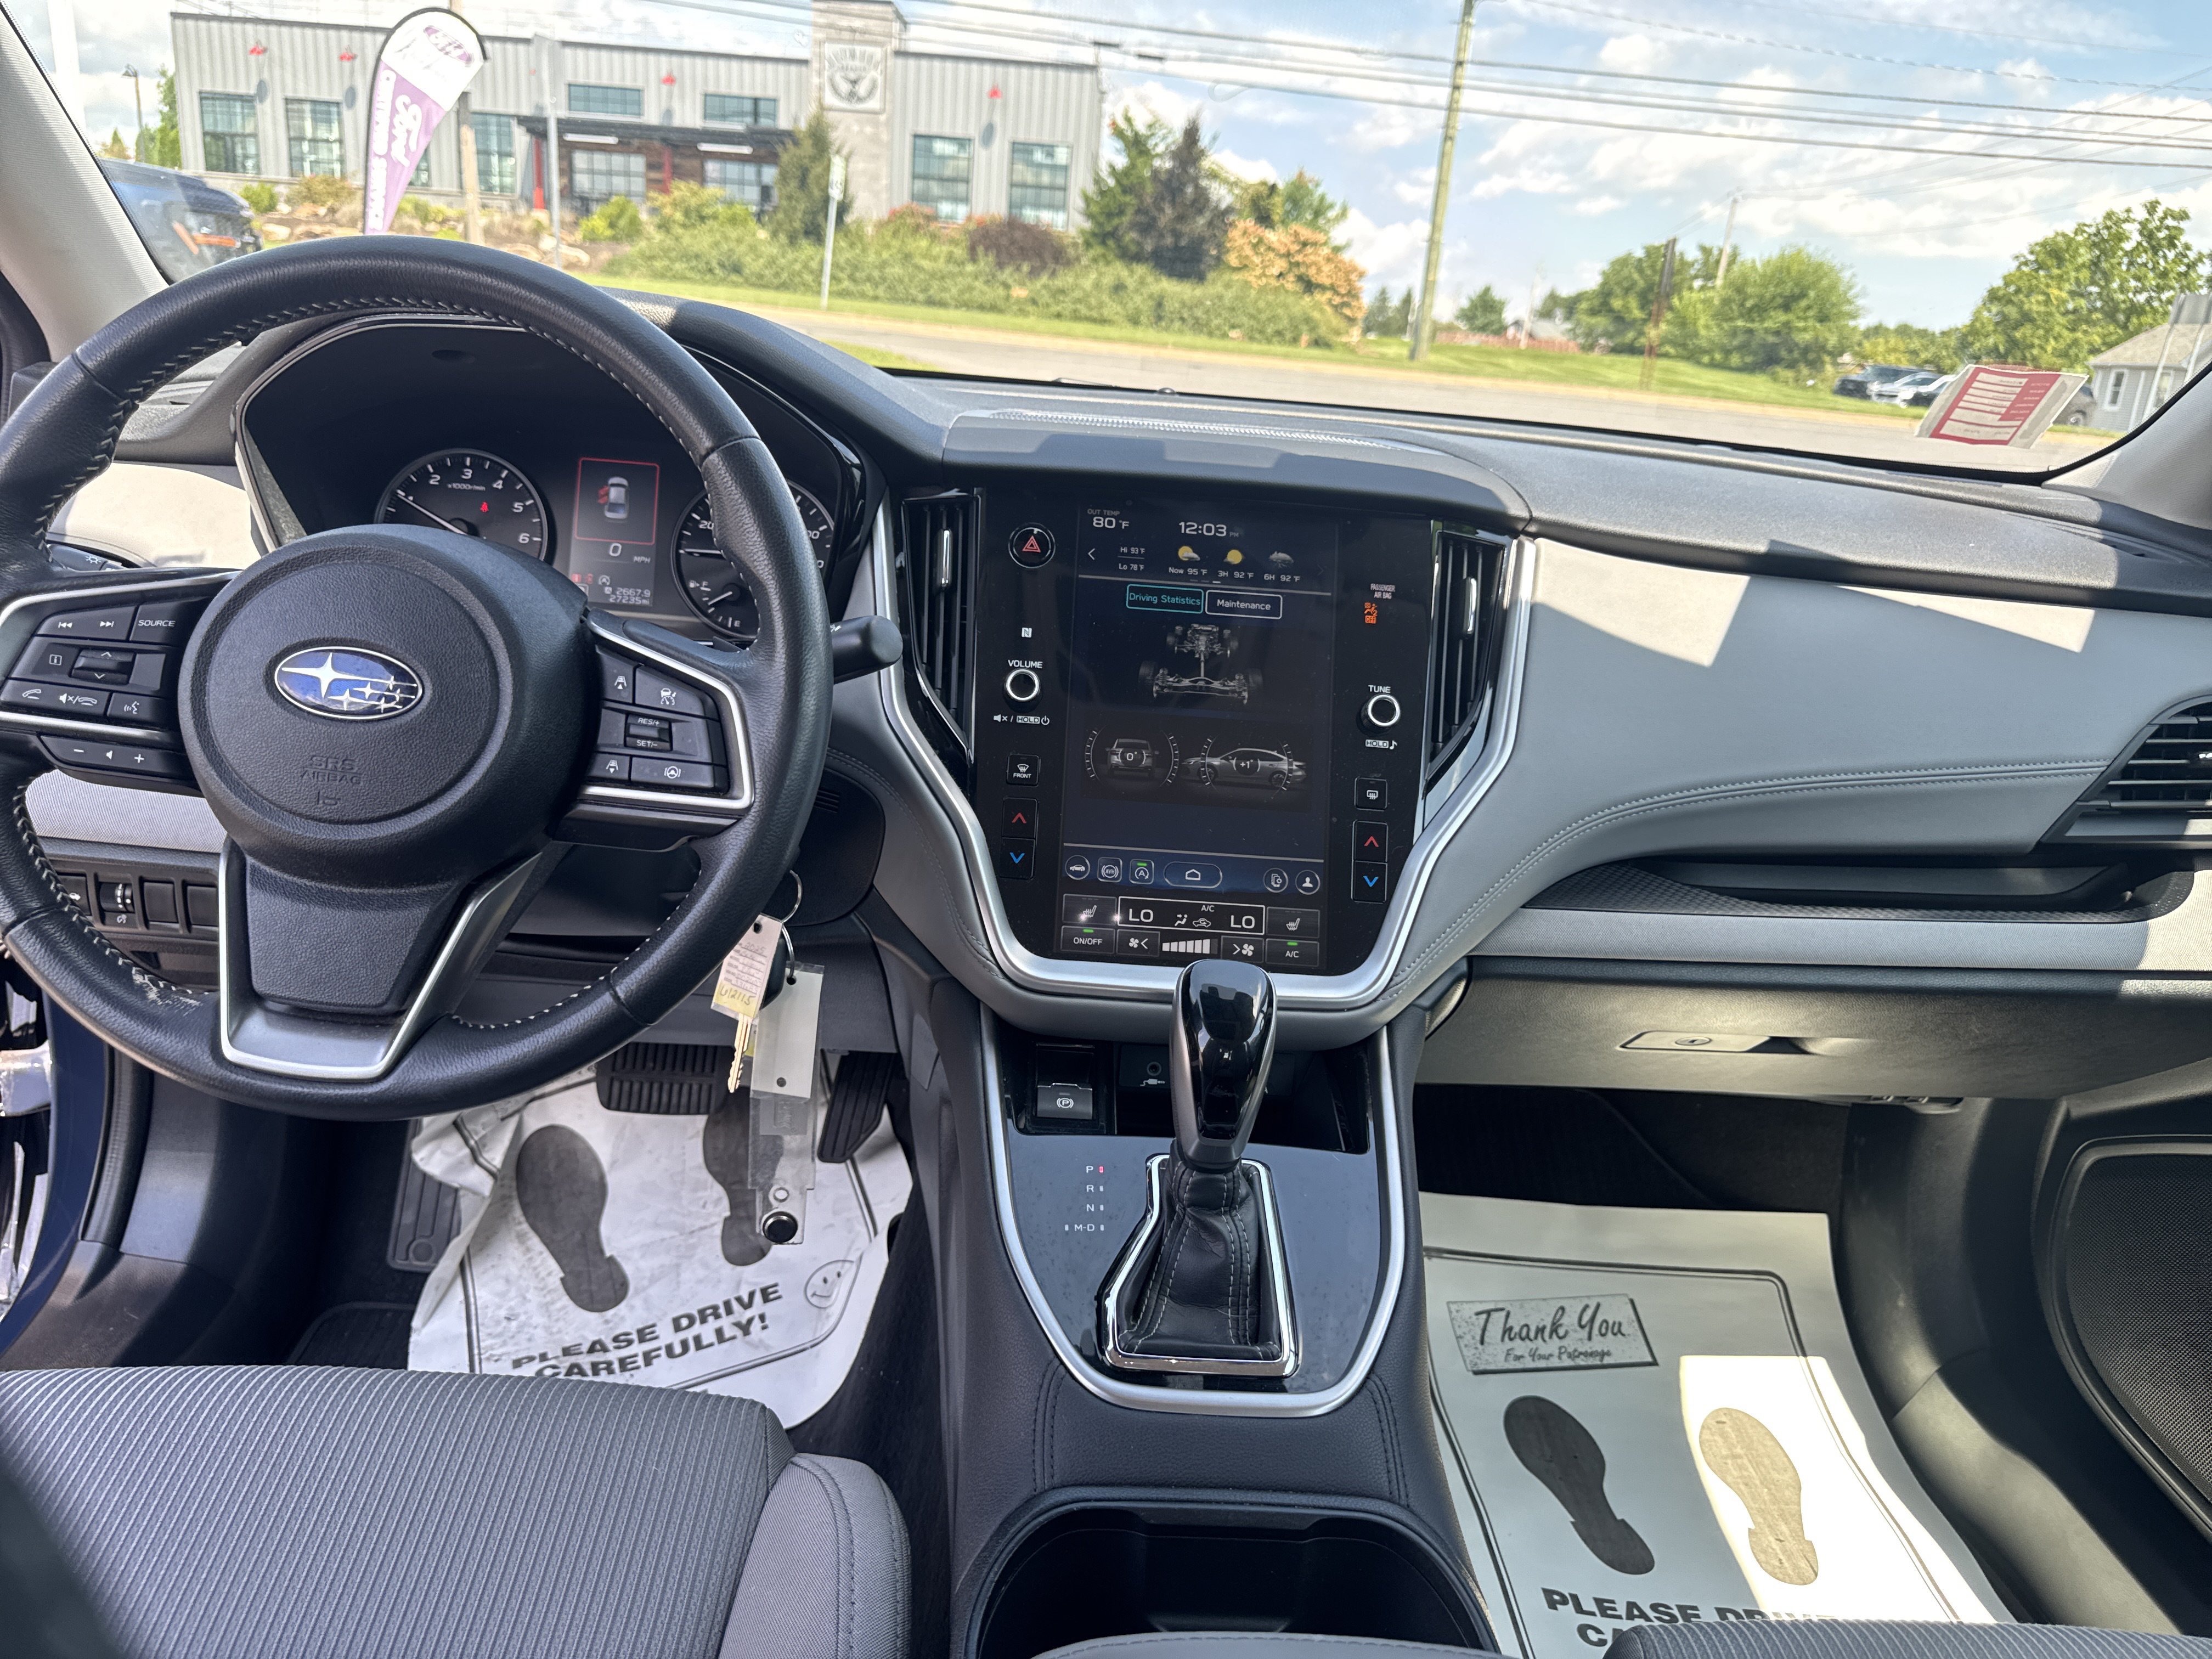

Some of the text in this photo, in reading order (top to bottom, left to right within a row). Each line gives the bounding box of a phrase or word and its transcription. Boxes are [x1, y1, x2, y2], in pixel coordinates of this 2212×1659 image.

[429, 475, 441, 485] 2
[461, 469, 472, 479] 3
[492, 479, 504, 490] 4
[512, 502, 524, 512] 5
[1179, 522, 1227, 537] 12:03
[518, 533, 530, 543] 6
[609, 543, 622, 556] 0
[1169, 567, 1184, 575] Now
[1370, 583, 1395, 592] PASSENGER
[1129, 592, 1200, 606] Driving Statistics
[1217, 599, 1271, 610] Maintenance
[138, 619, 176, 628] SOURCE
[1008, 659, 1043, 669] VOLUME
[1368, 685, 1391, 693] TUNE
[311, 755, 357, 771] SRS
[302, 770, 362, 785] AIRBAG
[1128, 909, 1153, 922] LO
[1230, 915, 1255, 929] LO
[1073, 936, 1103, 946] ON/OFF
[512, 1282, 783, 1369] PLEASE DRIVE
[1474, 1301, 1627, 1346] Thank You
[534, 1312, 769, 1378] CAREFULLY!
[1504, 1345, 1612, 1363] For Your Patronage
[1541, 1587, 1702, 1624] PLEASE
